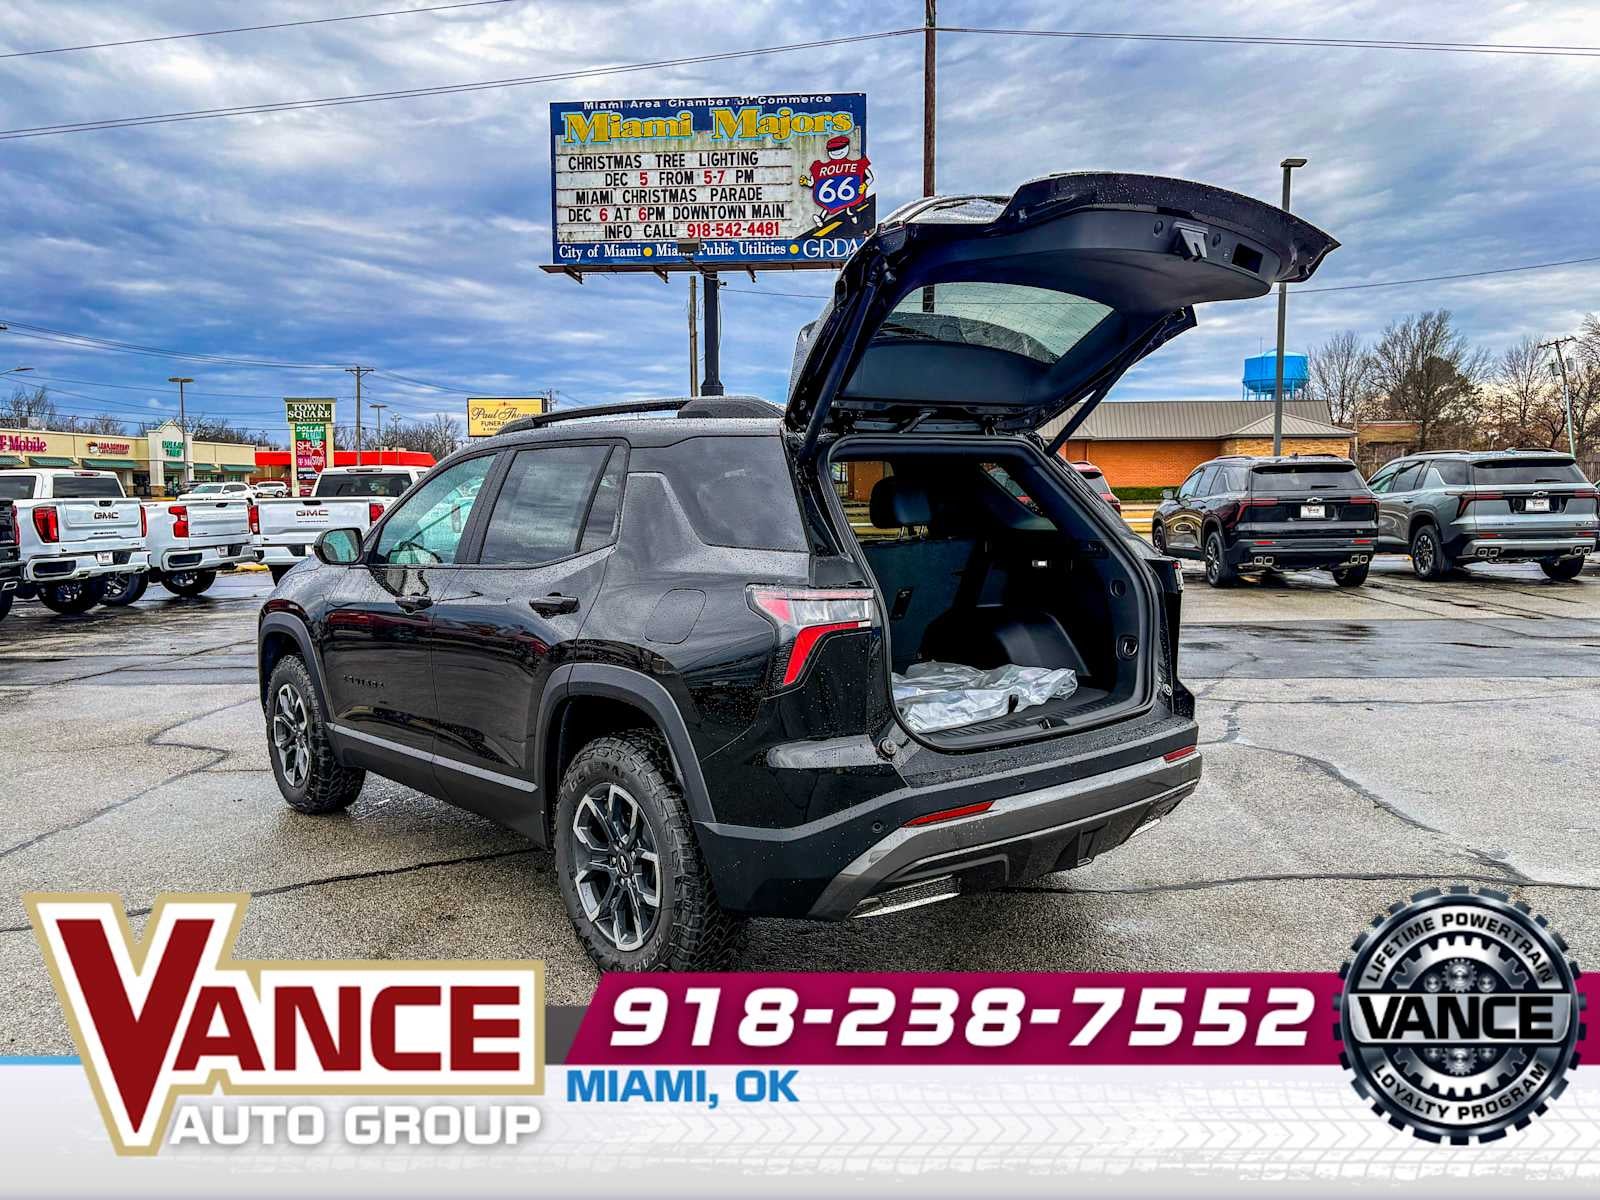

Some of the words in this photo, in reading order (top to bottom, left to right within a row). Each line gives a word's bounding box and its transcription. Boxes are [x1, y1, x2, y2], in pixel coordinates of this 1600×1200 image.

[583, 100, 623, 110] Miami
[629, 99, 661, 109] Area
[668, 97, 730, 107] Chamber
[757, 94, 832, 105] Commerce
[564, 112, 693, 143] Miami
[711, 108, 853, 140] Majors
[568, 155, 642, 170] CHRISTMAS
[655, 153, 685, 168] TREE
[699, 151, 759, 167] LIGHTING
[605, 172, 628, 187] DEC
[639, 172, 648, 186] 5
[659, 171, 694, 186] FROM
[703, 169, 726, 184] 5-7
[735, 169, 754, 183] PM
[819, 163, 858, 177] ROUTE
[575, 191, 613, 205] MIAMI
[622, 188, 697, 204] CHRISTMAS
[710, 187, 762, 201] PARADE
[818, 176, 856, 203] 66
[568, 208, 592, 222] DEC
[599, 207, 608, 222] 6
[614, 207, 632, 221] AT
[673, 204, 746, 220] DOWNTOWN
[751, 203, 785, 219] MAIN
[604, 225, 632, 239] INFO
[643, 223, 677, 238] CALL
[686, 222, 780, 239] 918-542-4481
[559, 244, 583, 262] City
[587, 244, 599, 258] of
[604, 244, 641, 257] Miami
[655, 243, 695, 257] Mia
[698, 241, 735, 257] Public
[739, 240, 786, 255] Utilities
[803, 238, 860, 257] GRDA
[288, 410, 331, 419] SQUARE
[471, 407, 499, 421] Paul
[94, 511, 119, 519] GMC
